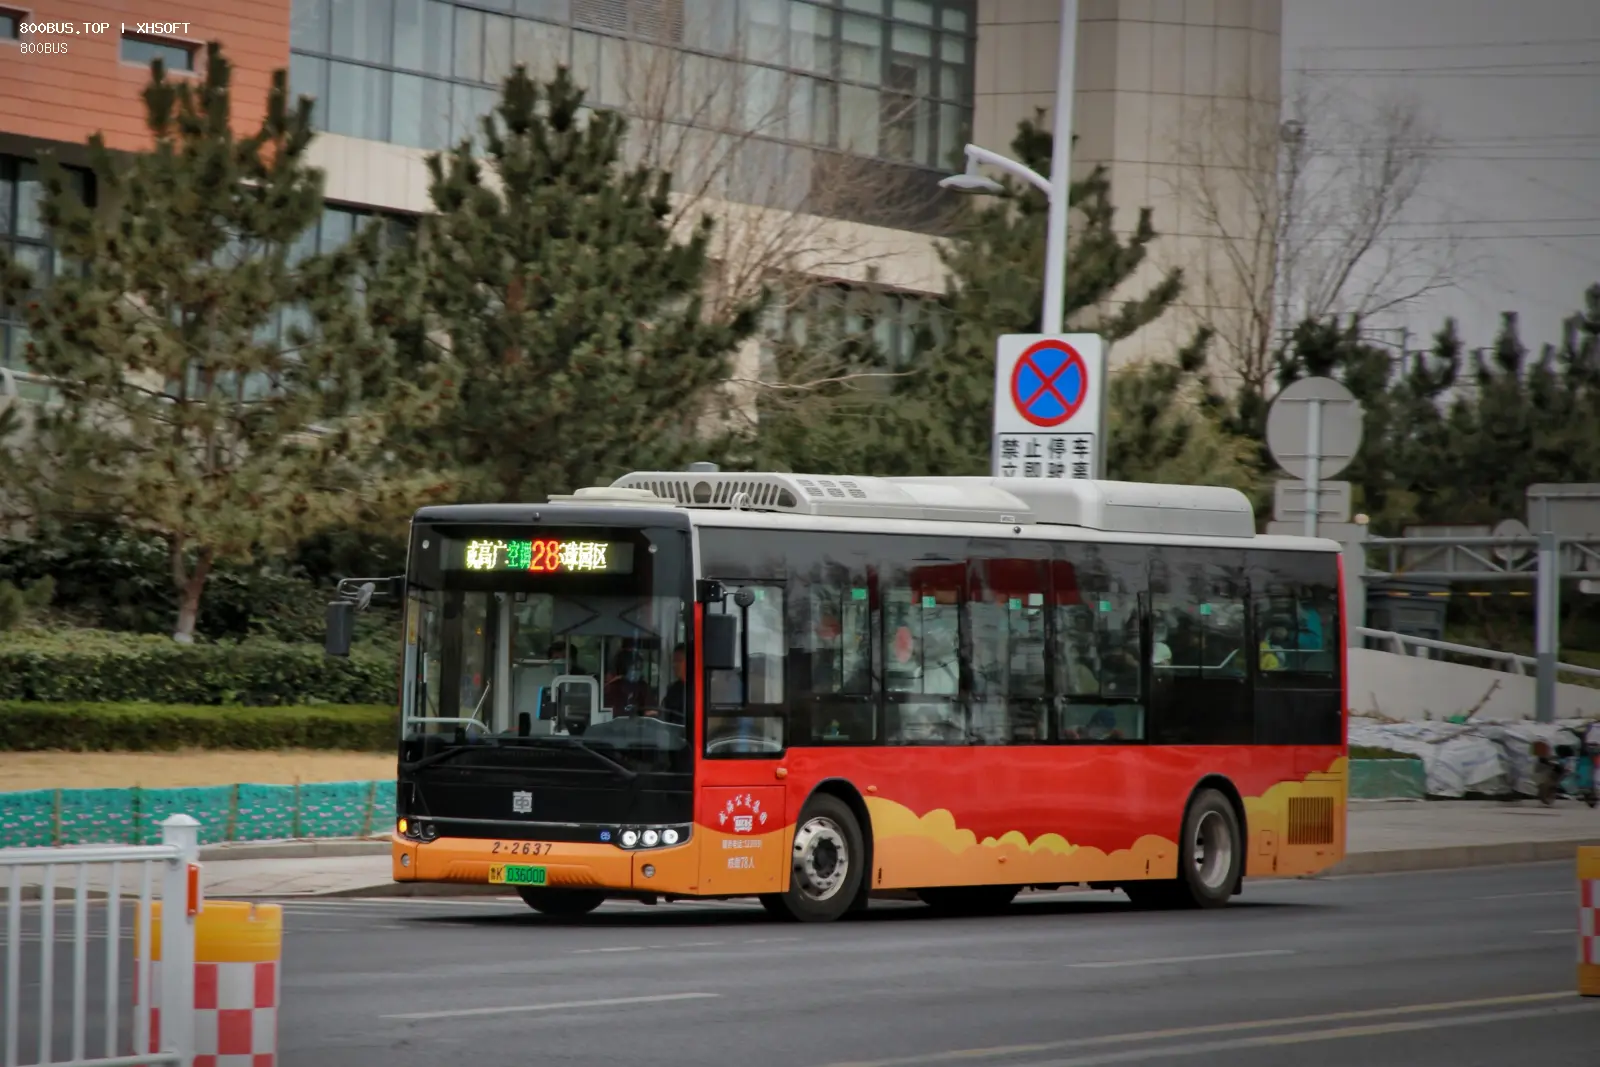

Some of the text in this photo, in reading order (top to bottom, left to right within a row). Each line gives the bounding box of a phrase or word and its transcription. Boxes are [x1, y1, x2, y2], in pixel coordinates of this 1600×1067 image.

[1001, 437, 1090, 459] 禁止停车
[530, 539, 561, 571] 28
